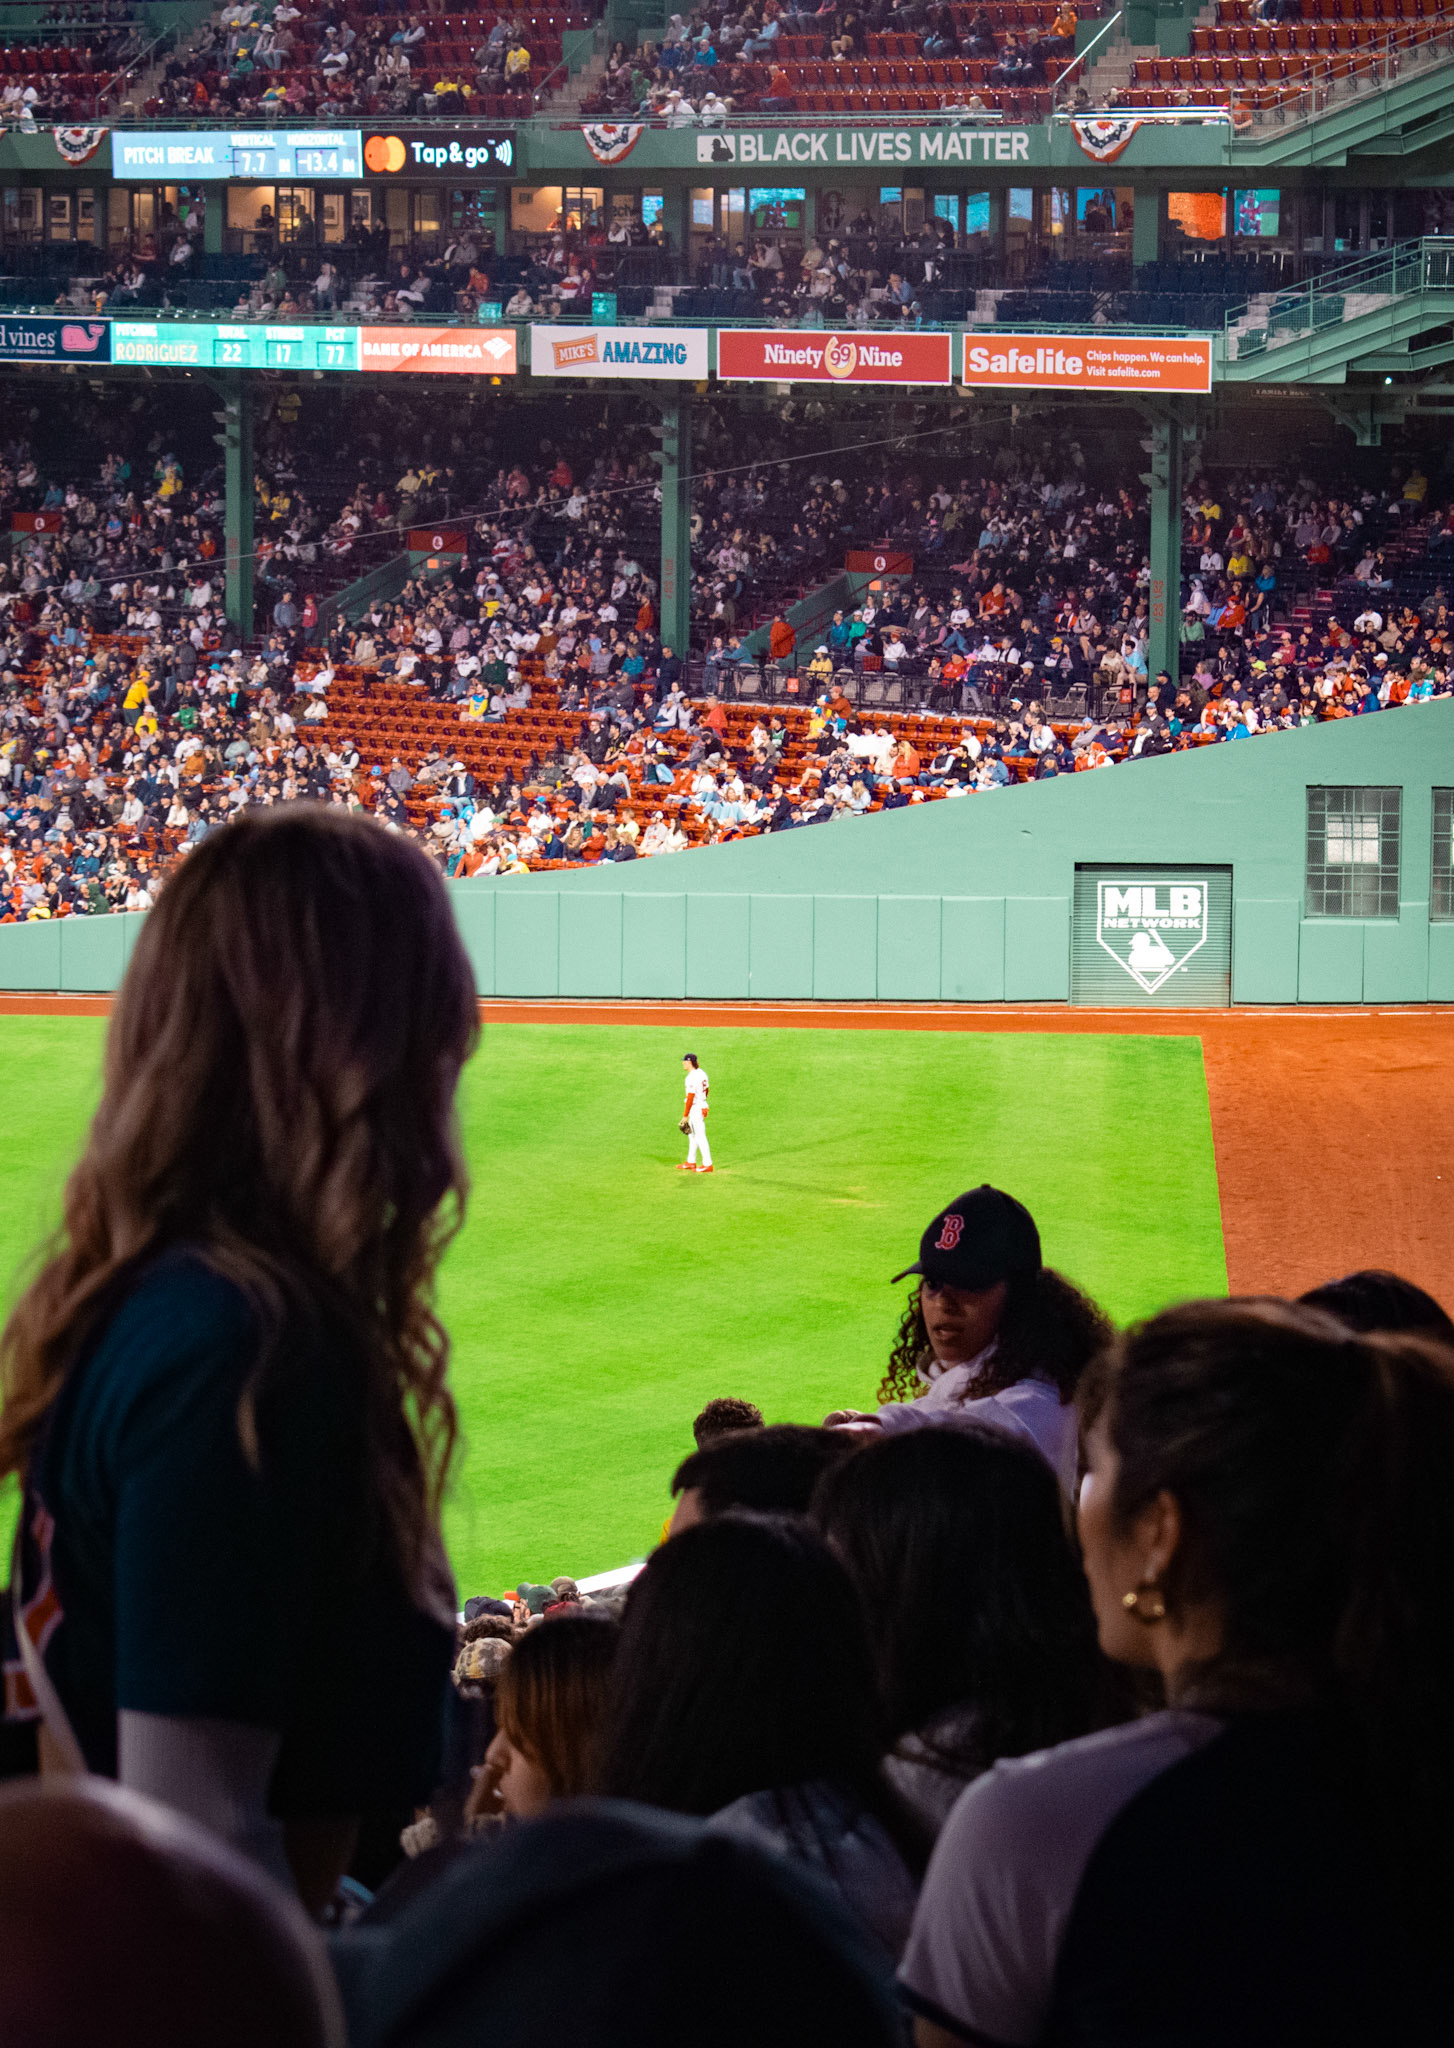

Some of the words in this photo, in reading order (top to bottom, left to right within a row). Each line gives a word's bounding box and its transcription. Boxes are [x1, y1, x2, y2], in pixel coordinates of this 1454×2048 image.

[230, 134, 276, 146] VERTICAL
[287, 134, 347, 146] HORIZONTAL
[740, 134, 828, 161] BLACK
[836, 133, 911, 161] LIVES
[920, 132, 1030, 160] MATTER
[123, 147, 163, 164] PITCH
[167, 147, 214, 164] BREAK
[241, 153, 266, 172] 7.7
[298, 152, 338, 172] -13.4
[9, 326, 56, 347] vines
[216, 325, 248, 339] TOTAL
[222, 343, 241, 362] 22
[276, 344, 291, 363] 17
[326, 346, 345, 364] 77
[364, 342, 400, 357] BANK
[401, 343, 420, 357] OF
[421, 344, 482, 358] AMERICA
[559, 338, 594, 362] MIKE'S
[602, 341, 687, 365] AMAZING
[764, 344, 824, 369] Ninety
[830, 343, 851, 366] 99
[859, 346, 903, 367] Nine
[1086, 350, 1112, 362] Chips
[1113, 351, 1149, 363] happen.
[1150, 352, 1165, 362] We
[1165, 355, 1182, 364] can
[1183, 353, 1205, 366] help.
[968, 347, 1083, 375] Safelite
[1087, 365, 1106, 376] Visit
[1107, 366, 1161, 377] safelite.com
[1104, 887, 1202, 918] MLB
[1103, 917, 1201, 928] NETWORK
[935, 1214, 965, 1250] B
